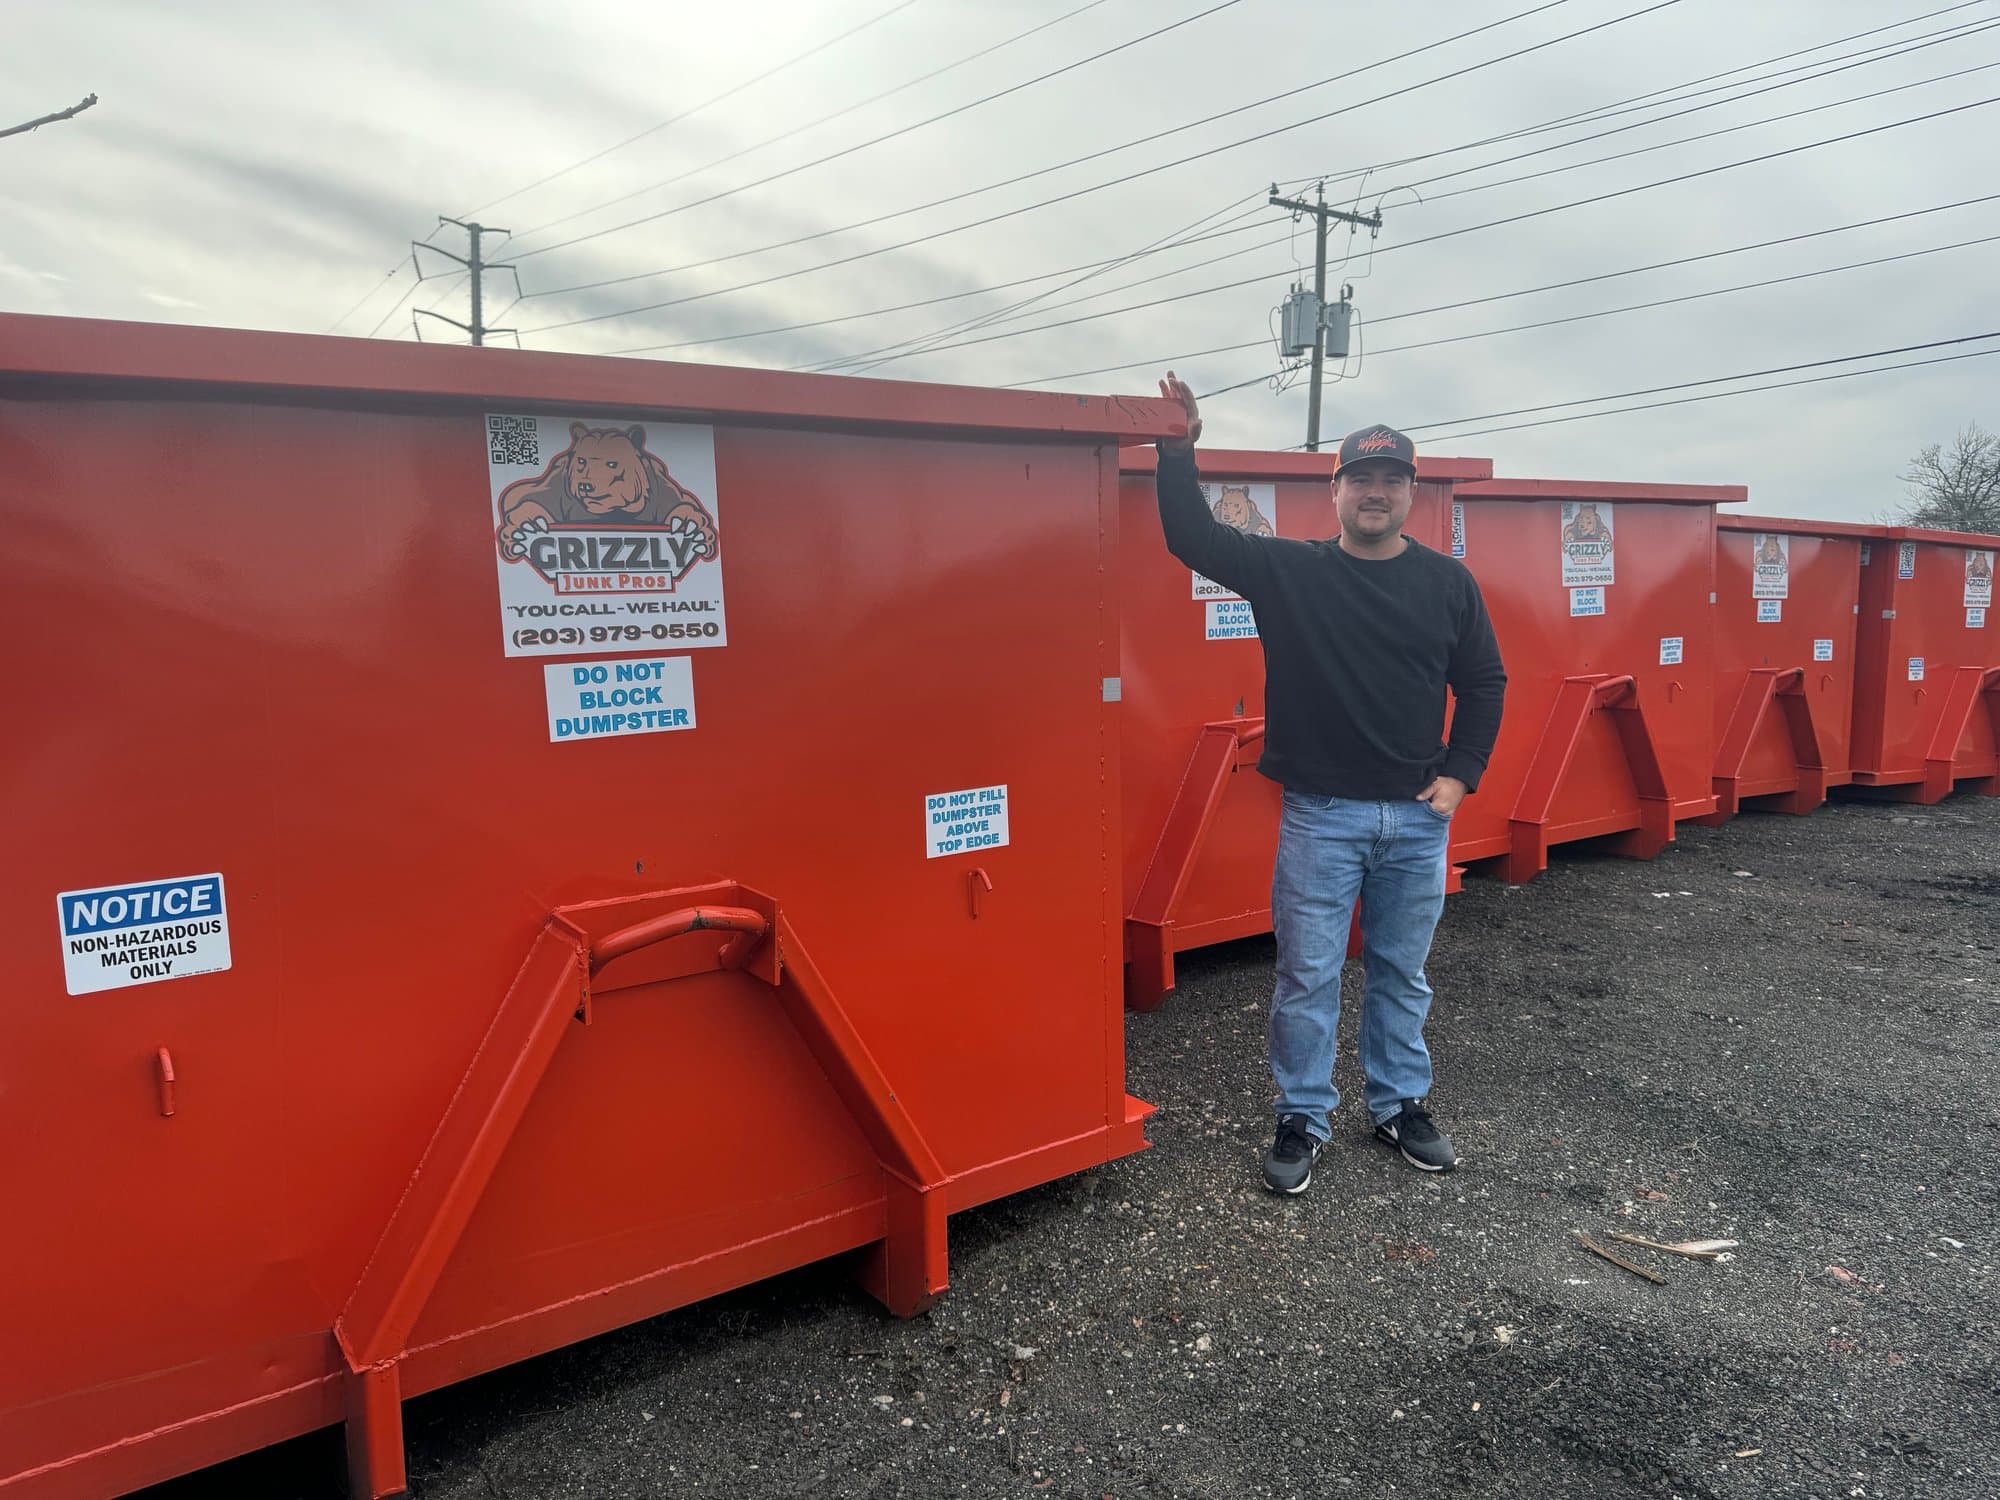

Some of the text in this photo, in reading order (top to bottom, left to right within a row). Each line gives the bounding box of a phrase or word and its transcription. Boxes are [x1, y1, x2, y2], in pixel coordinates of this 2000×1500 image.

[529, 537, 695, 571] GRIZZLY
[1568, 543, 1607, 556] GRIZZLY
[563, 573, 666, 590] JUNK PROS
[1195, 585, 1223, 596] (203)
[1216, 603, 1230, 612] DO
[1577, 597, 1598, 606] BLOCK
[1218, 615, 1251, 625] BLOCK
[512, 622, 719, 648] (203) 979-0550
[573, 662, 665, 686] DO NOT
[579, 686, 663, 710] BLOCK
[556, 708, 689, 737] DUMPSTER
[928, 788, 1005, 810] DO NOT FILL
[932, 803, 1001, 824] DUMPSTER
[946, 820, 989, 837] ABOVE
[936, 833, 1000, 853] TOP EDGE
[72, 884, 213, 929] NOTICE
[70, 919, 222, 955] NON-HAZARDOUS
[101, 940, 198, 967] MATERIALS
[130, 960, 173, 980] ONLY
